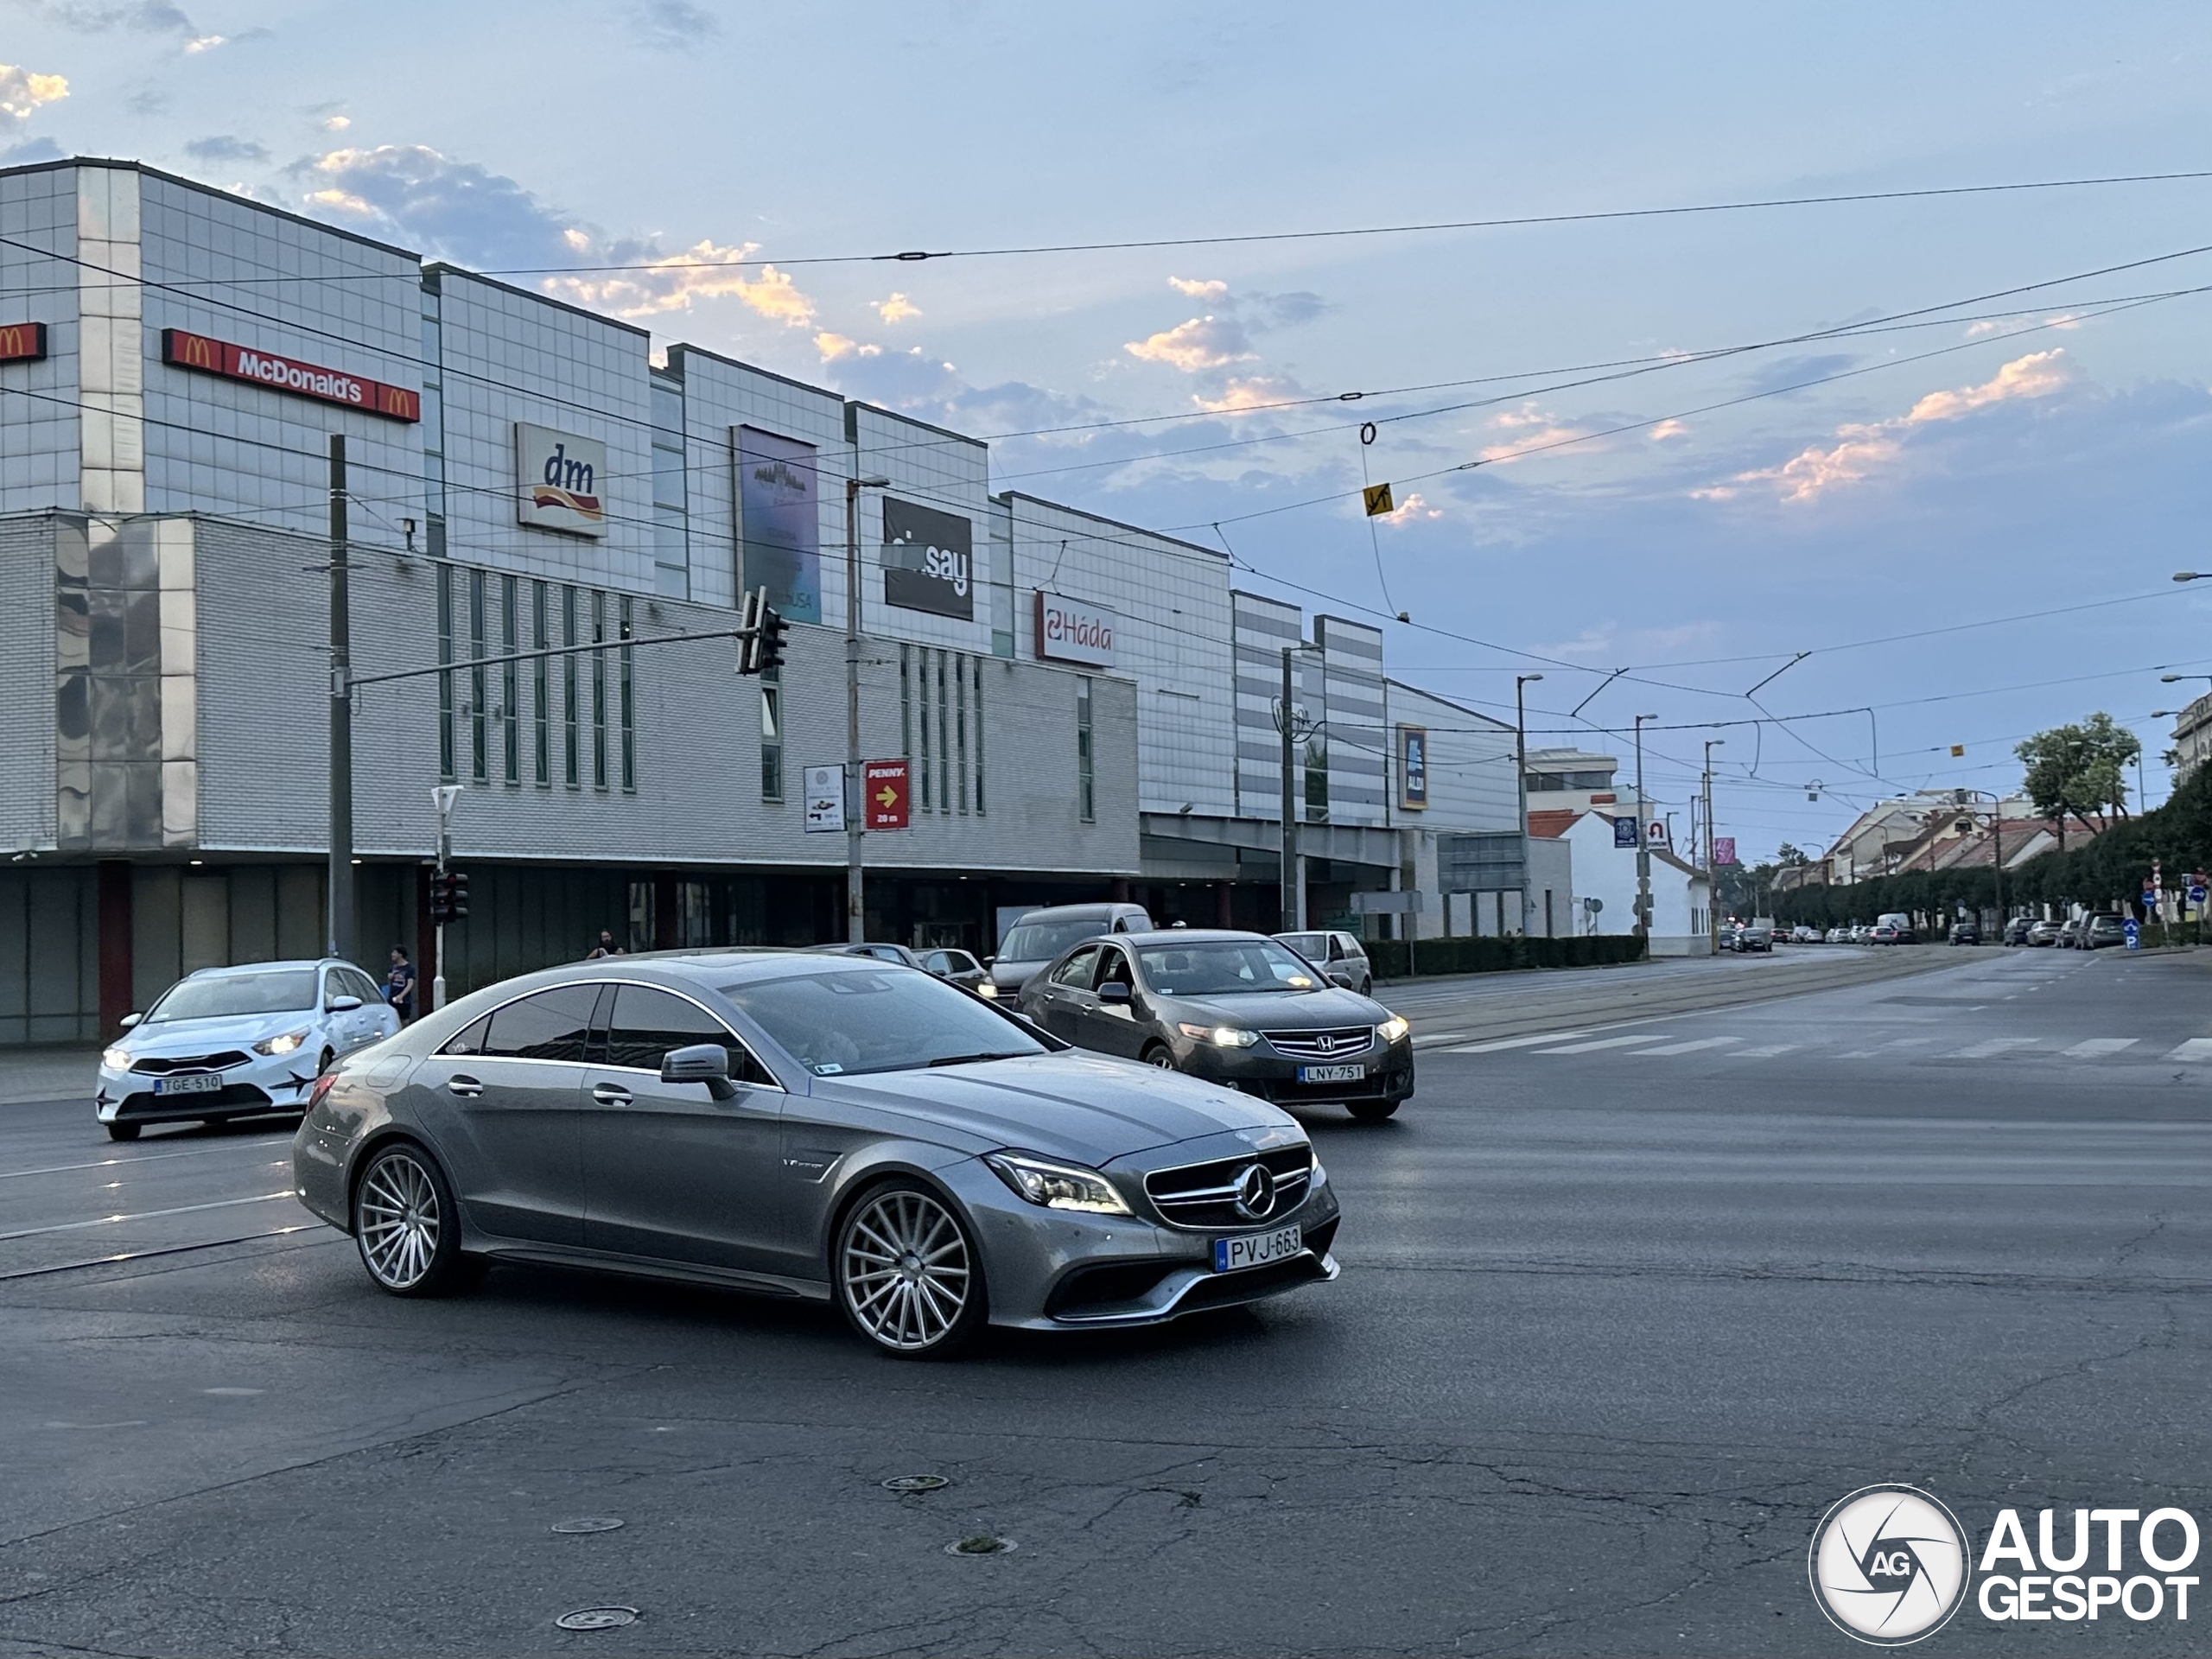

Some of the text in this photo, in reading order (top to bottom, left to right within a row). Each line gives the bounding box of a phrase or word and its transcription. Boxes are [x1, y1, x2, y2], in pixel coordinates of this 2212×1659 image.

[238, 352, 362, 403] McDonald's
[544, 442, 594, 494] dm
[1063, 612, 1112, 651] Háda
[1408, 775, 1424, 791] ALDI
[2126, 936, 2137, 950] P
[163, 1077, 219, 1092] TGE-510
[1306, 1066, 1361, 1081] LNY-751
[1231, 1228, 1299, 1266] PVJ-663
